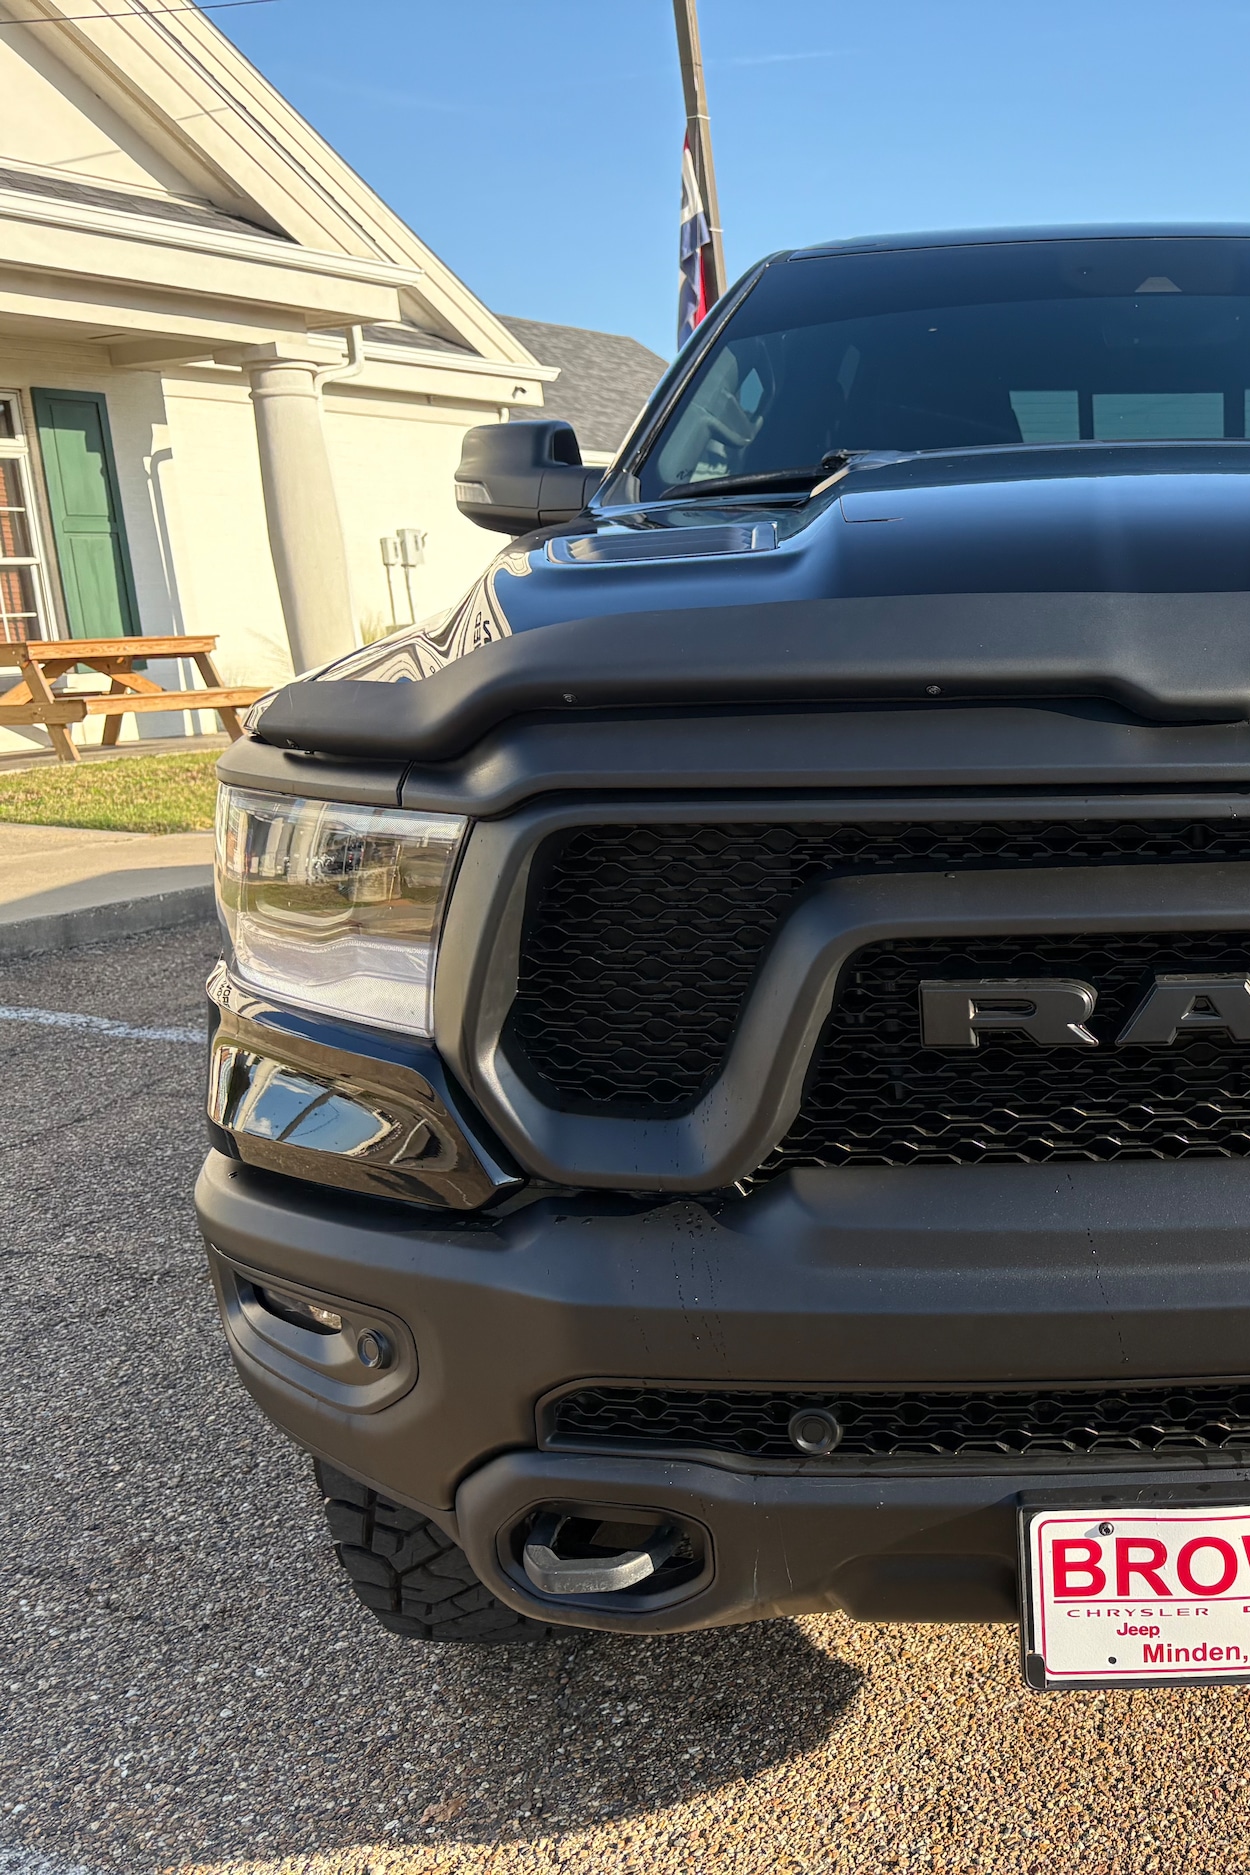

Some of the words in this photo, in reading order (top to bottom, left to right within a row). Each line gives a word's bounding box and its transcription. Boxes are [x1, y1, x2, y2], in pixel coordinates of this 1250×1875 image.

[1067, 1608, 1209, 1618] CHRYSLER
[1116, 1623, 1160, 1638] Jeep
[1143, 1642, 1249, 1664] Minden,
